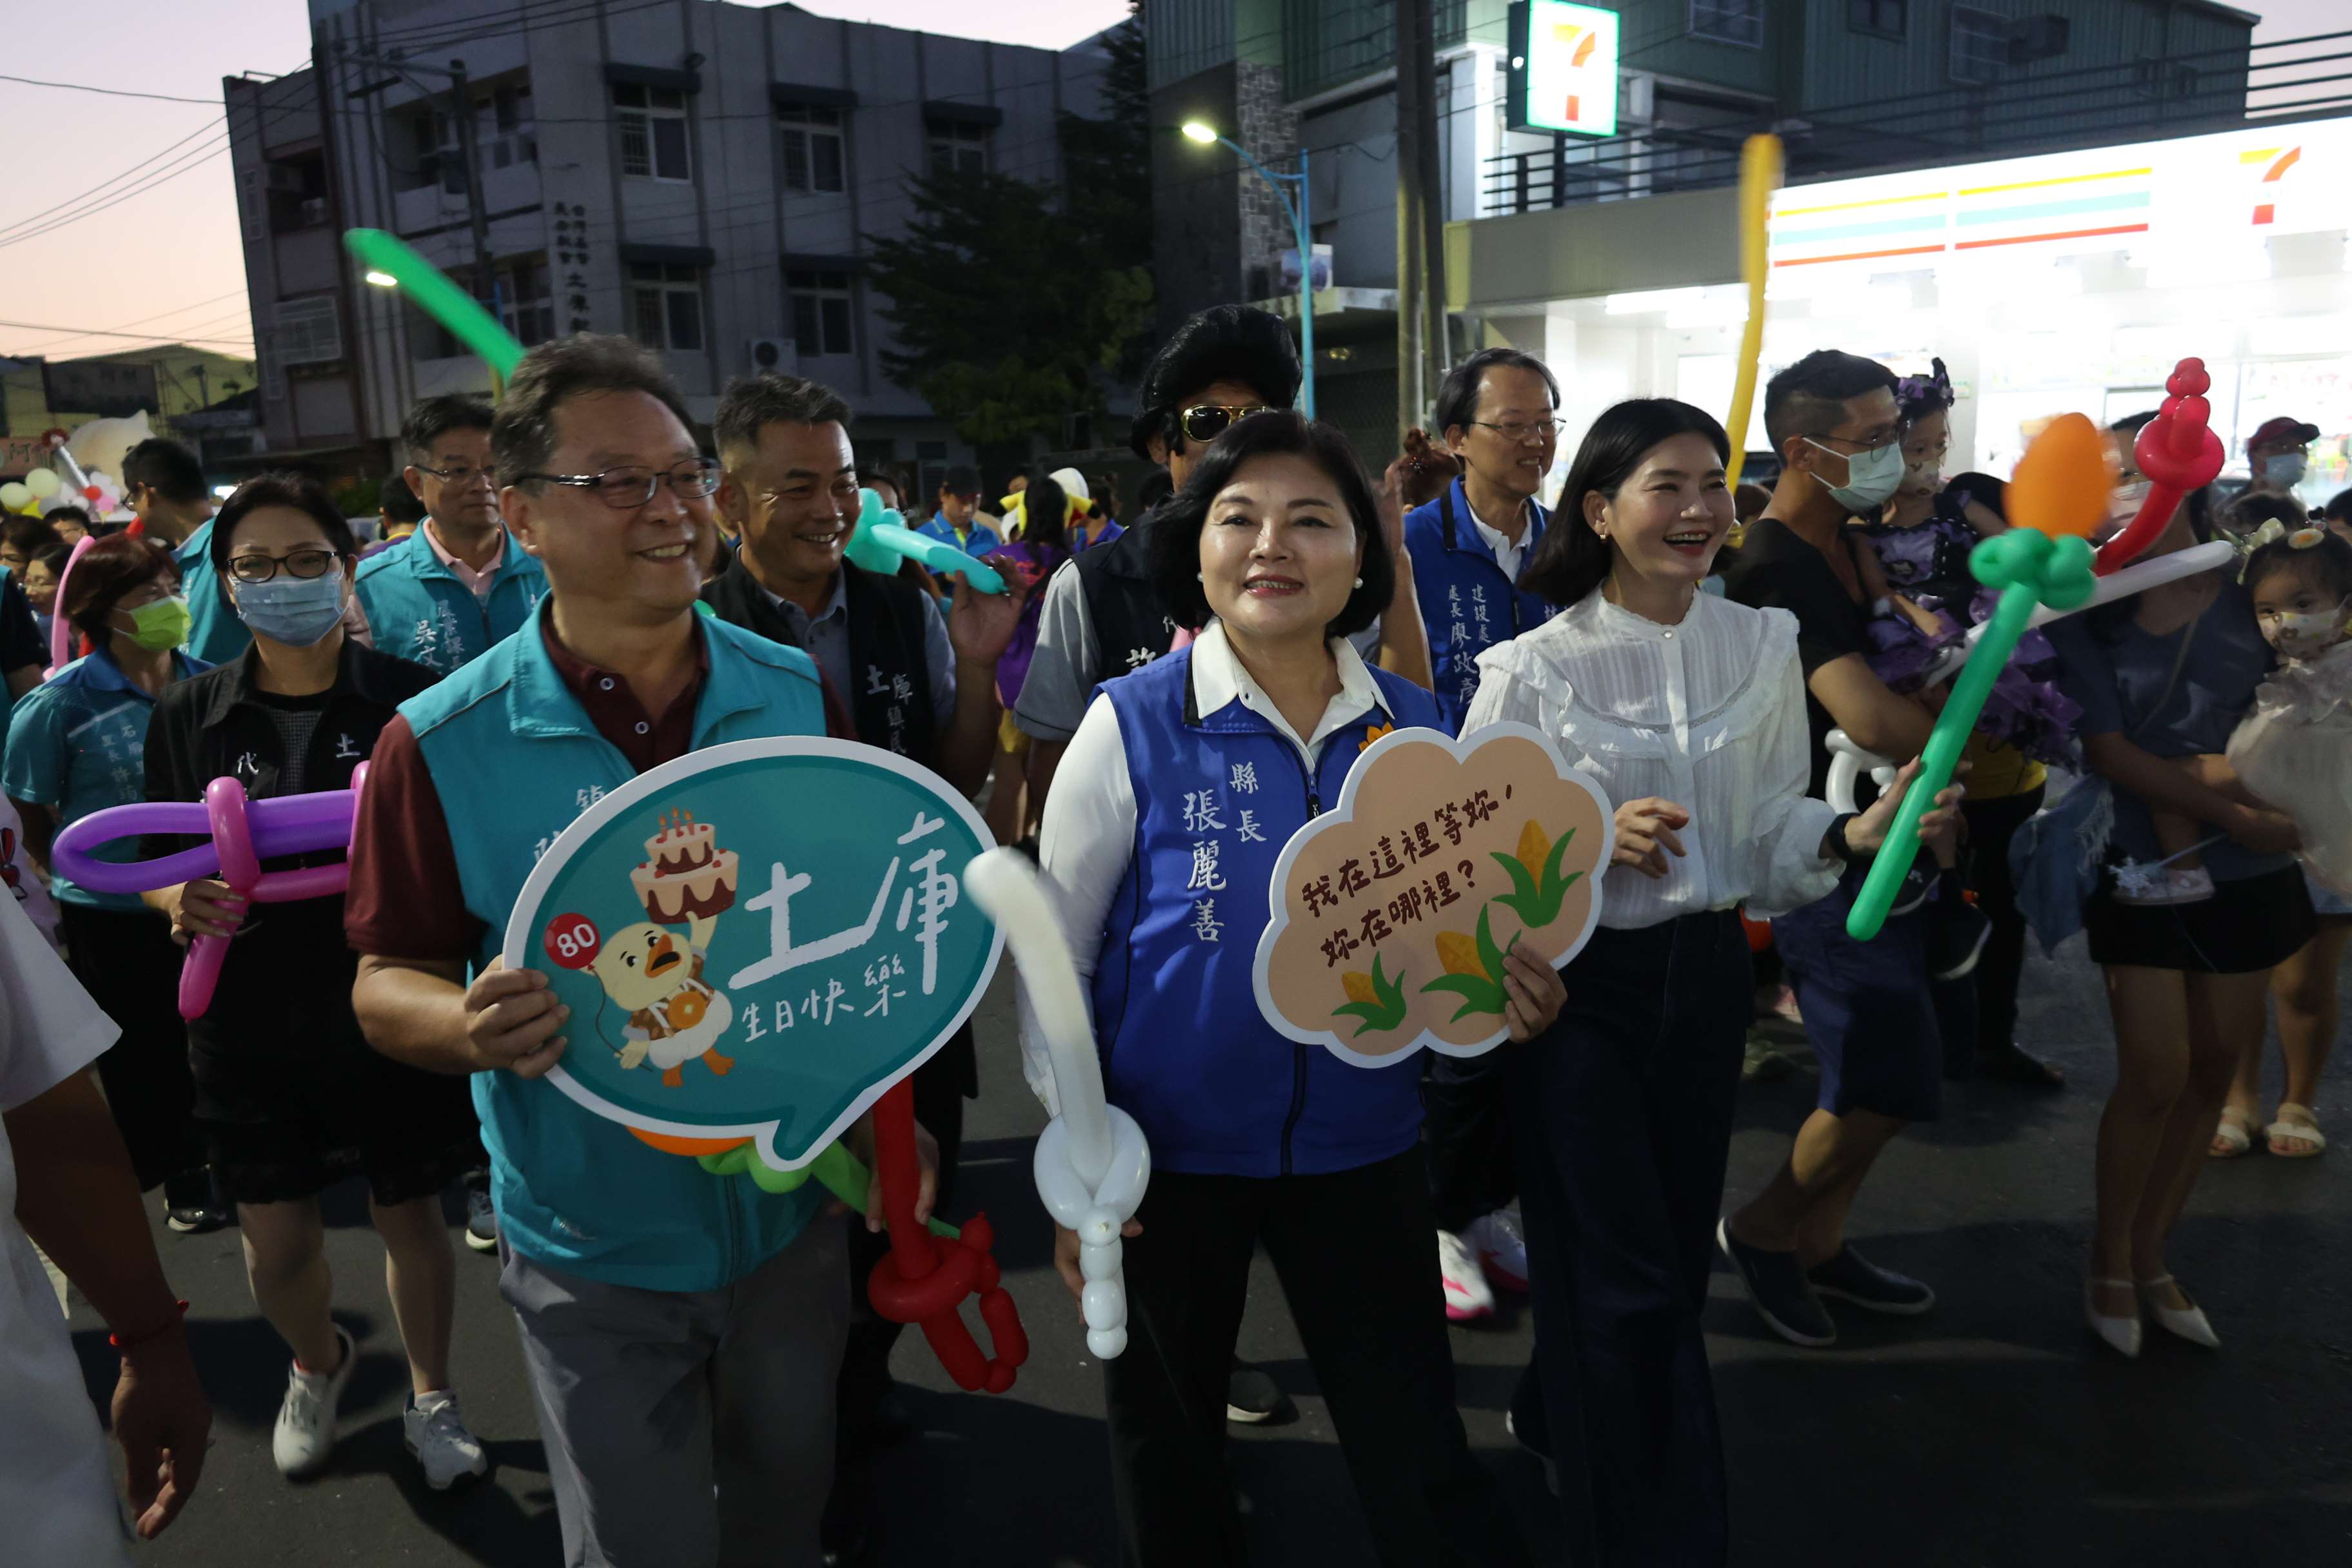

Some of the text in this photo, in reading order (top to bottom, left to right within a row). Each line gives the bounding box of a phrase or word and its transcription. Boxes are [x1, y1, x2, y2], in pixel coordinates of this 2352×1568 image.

[413, 619, 445, 675] 吳文
[335, 732, 362, 758] 土
[1229, 761, 1268, 843] 縣長
[728, 810, 960, 996] 土庫
[1182, 789, 1228, 943] 張麗善
[555, 923, 596, 959] 80
[741, 954, 906, 1043] 生日快樂
